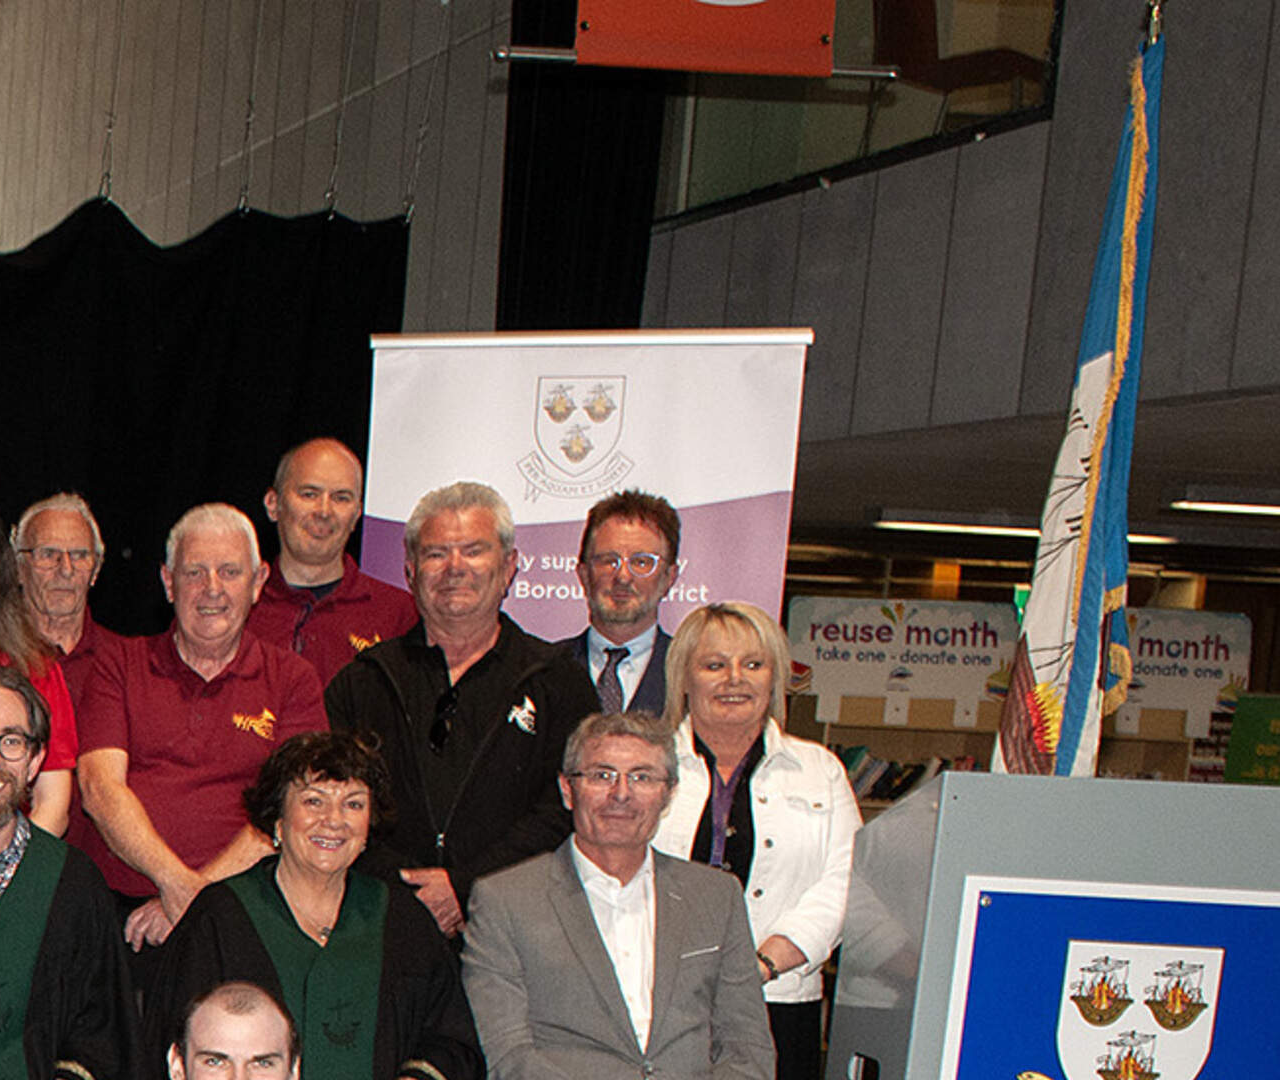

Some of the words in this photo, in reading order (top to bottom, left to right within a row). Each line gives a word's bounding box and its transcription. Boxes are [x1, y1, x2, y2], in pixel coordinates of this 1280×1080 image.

[514, 580, 586, 600] Borou
[809, 622, 894, 644] reuse
[905, 620, 998, 648] month
[815, 646, 851, 662] take
[856, 650, 887, 663] one
[899, 649, 958, 665] donate
[962, 653, 993, 666] one
[1137, 633, 1230, 661] month
[1133, 661, 1189, 678] donate
[1194, 667, 1224, 680] one
